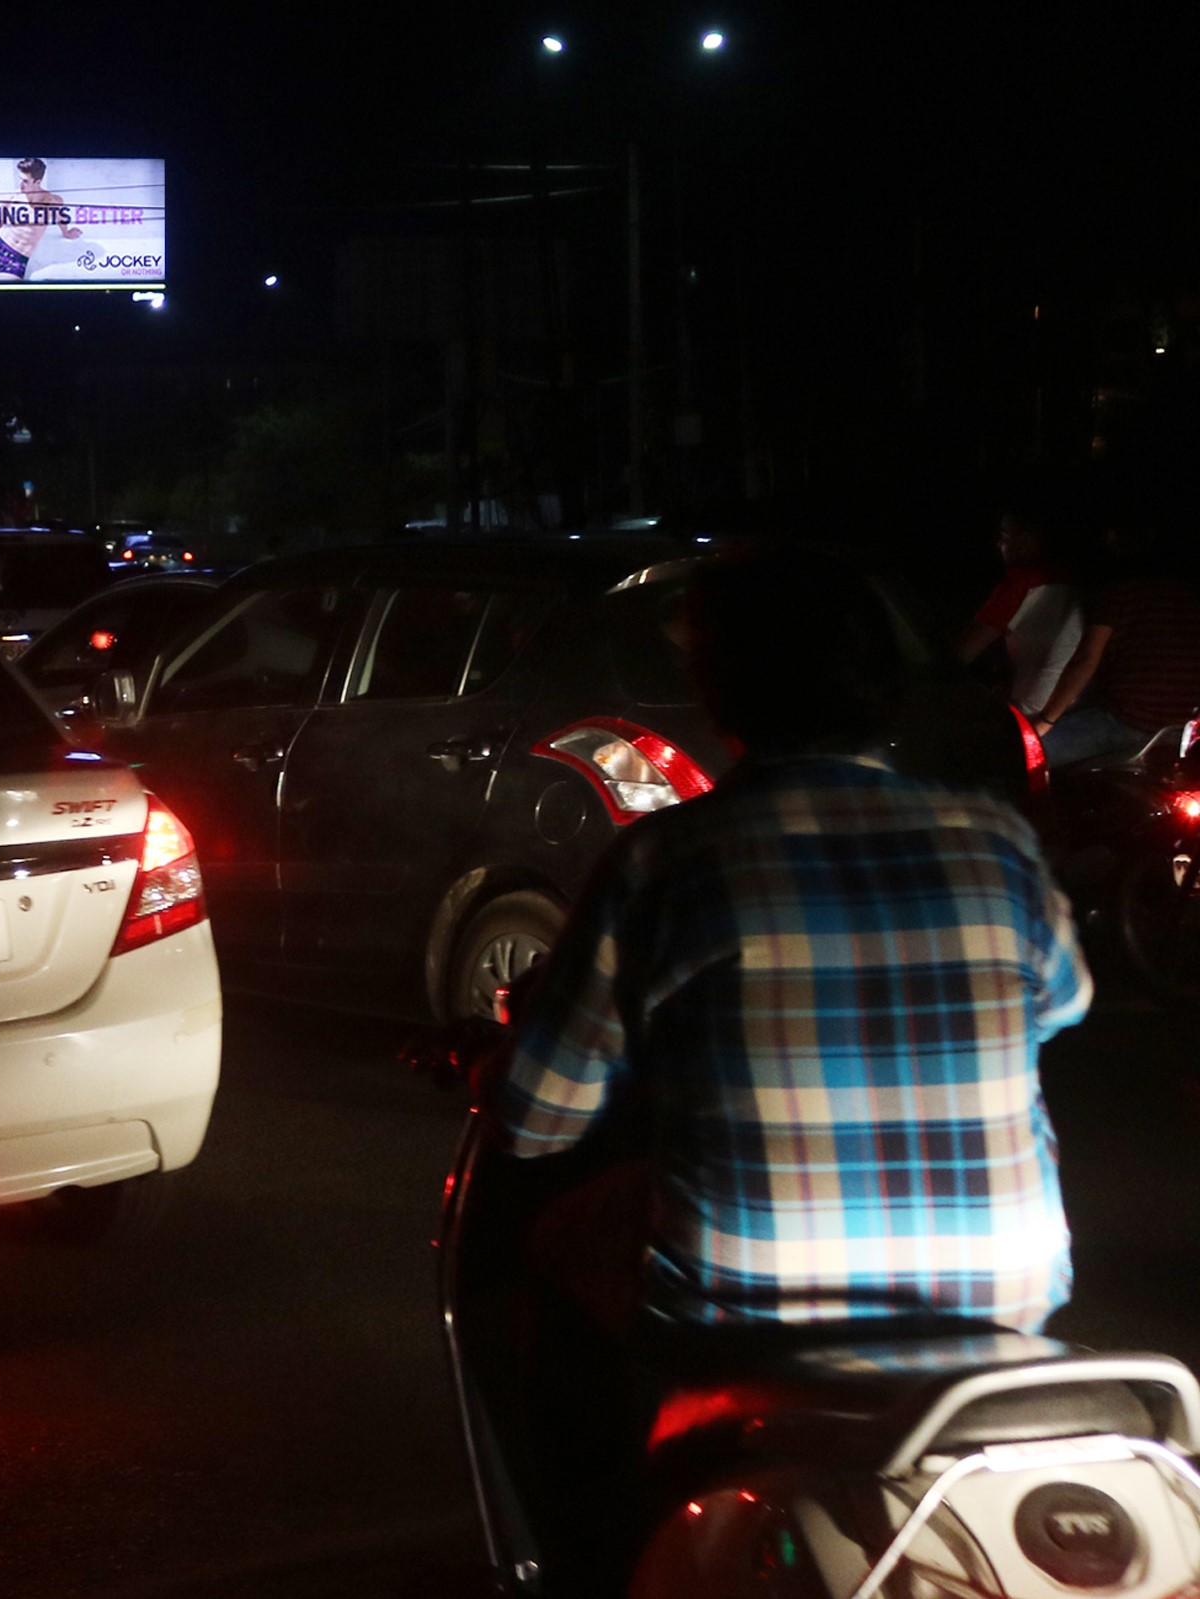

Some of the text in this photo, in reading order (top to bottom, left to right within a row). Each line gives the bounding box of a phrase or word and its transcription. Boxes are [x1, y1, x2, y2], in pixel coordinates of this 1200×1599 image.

[34, 206, 71, 225] FITS
[75, 207, 144, 225] BETTER
[99, 255, 162, 268] JOCKEY
[52, 799, 117, 815] SWIFT
